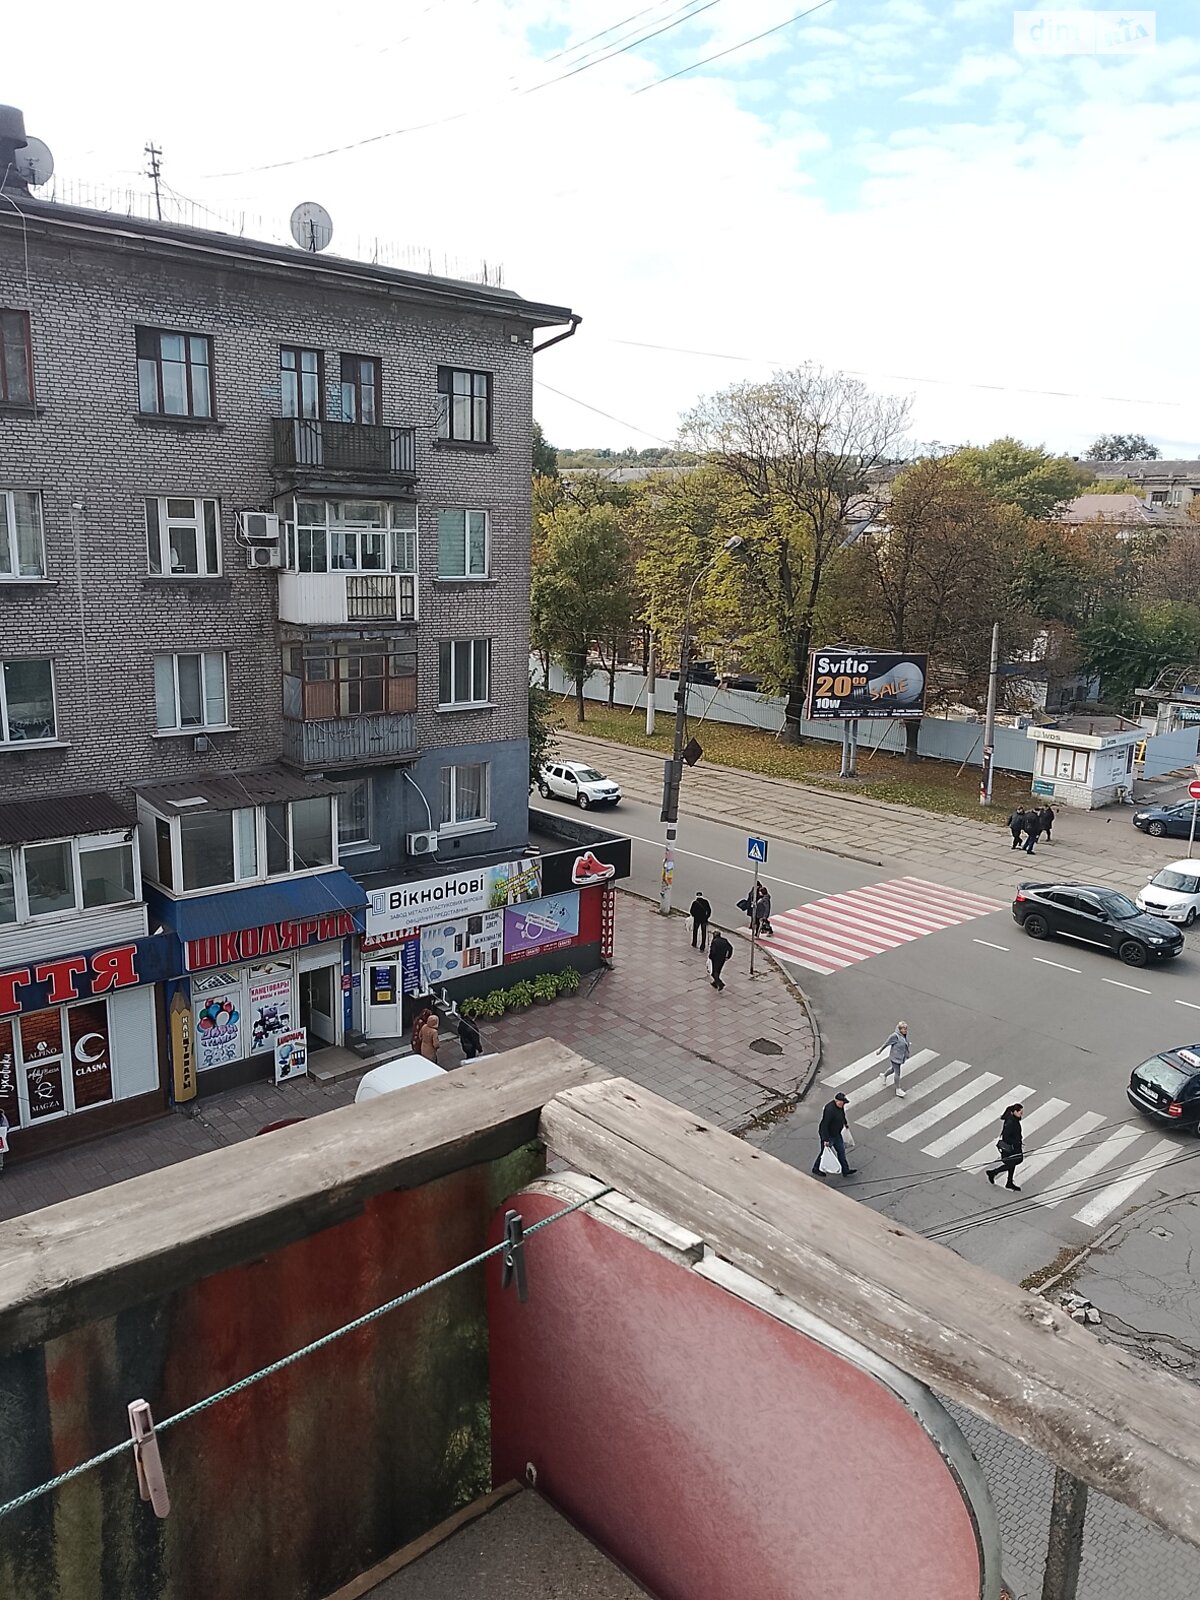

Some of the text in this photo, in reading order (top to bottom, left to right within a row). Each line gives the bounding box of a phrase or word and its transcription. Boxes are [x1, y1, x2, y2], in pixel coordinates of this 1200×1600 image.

[817, 657, 869, 674] Svitlo
[868, 678, 909, 701] SALE
[389, 874, 484, 910] ВікнаНові
[186, 912, 356, 971] ШКОЛЯРИК
[75, 1062, 108, 1077] CLASNA
[31, 1100, 60, 1113] MAGZA
